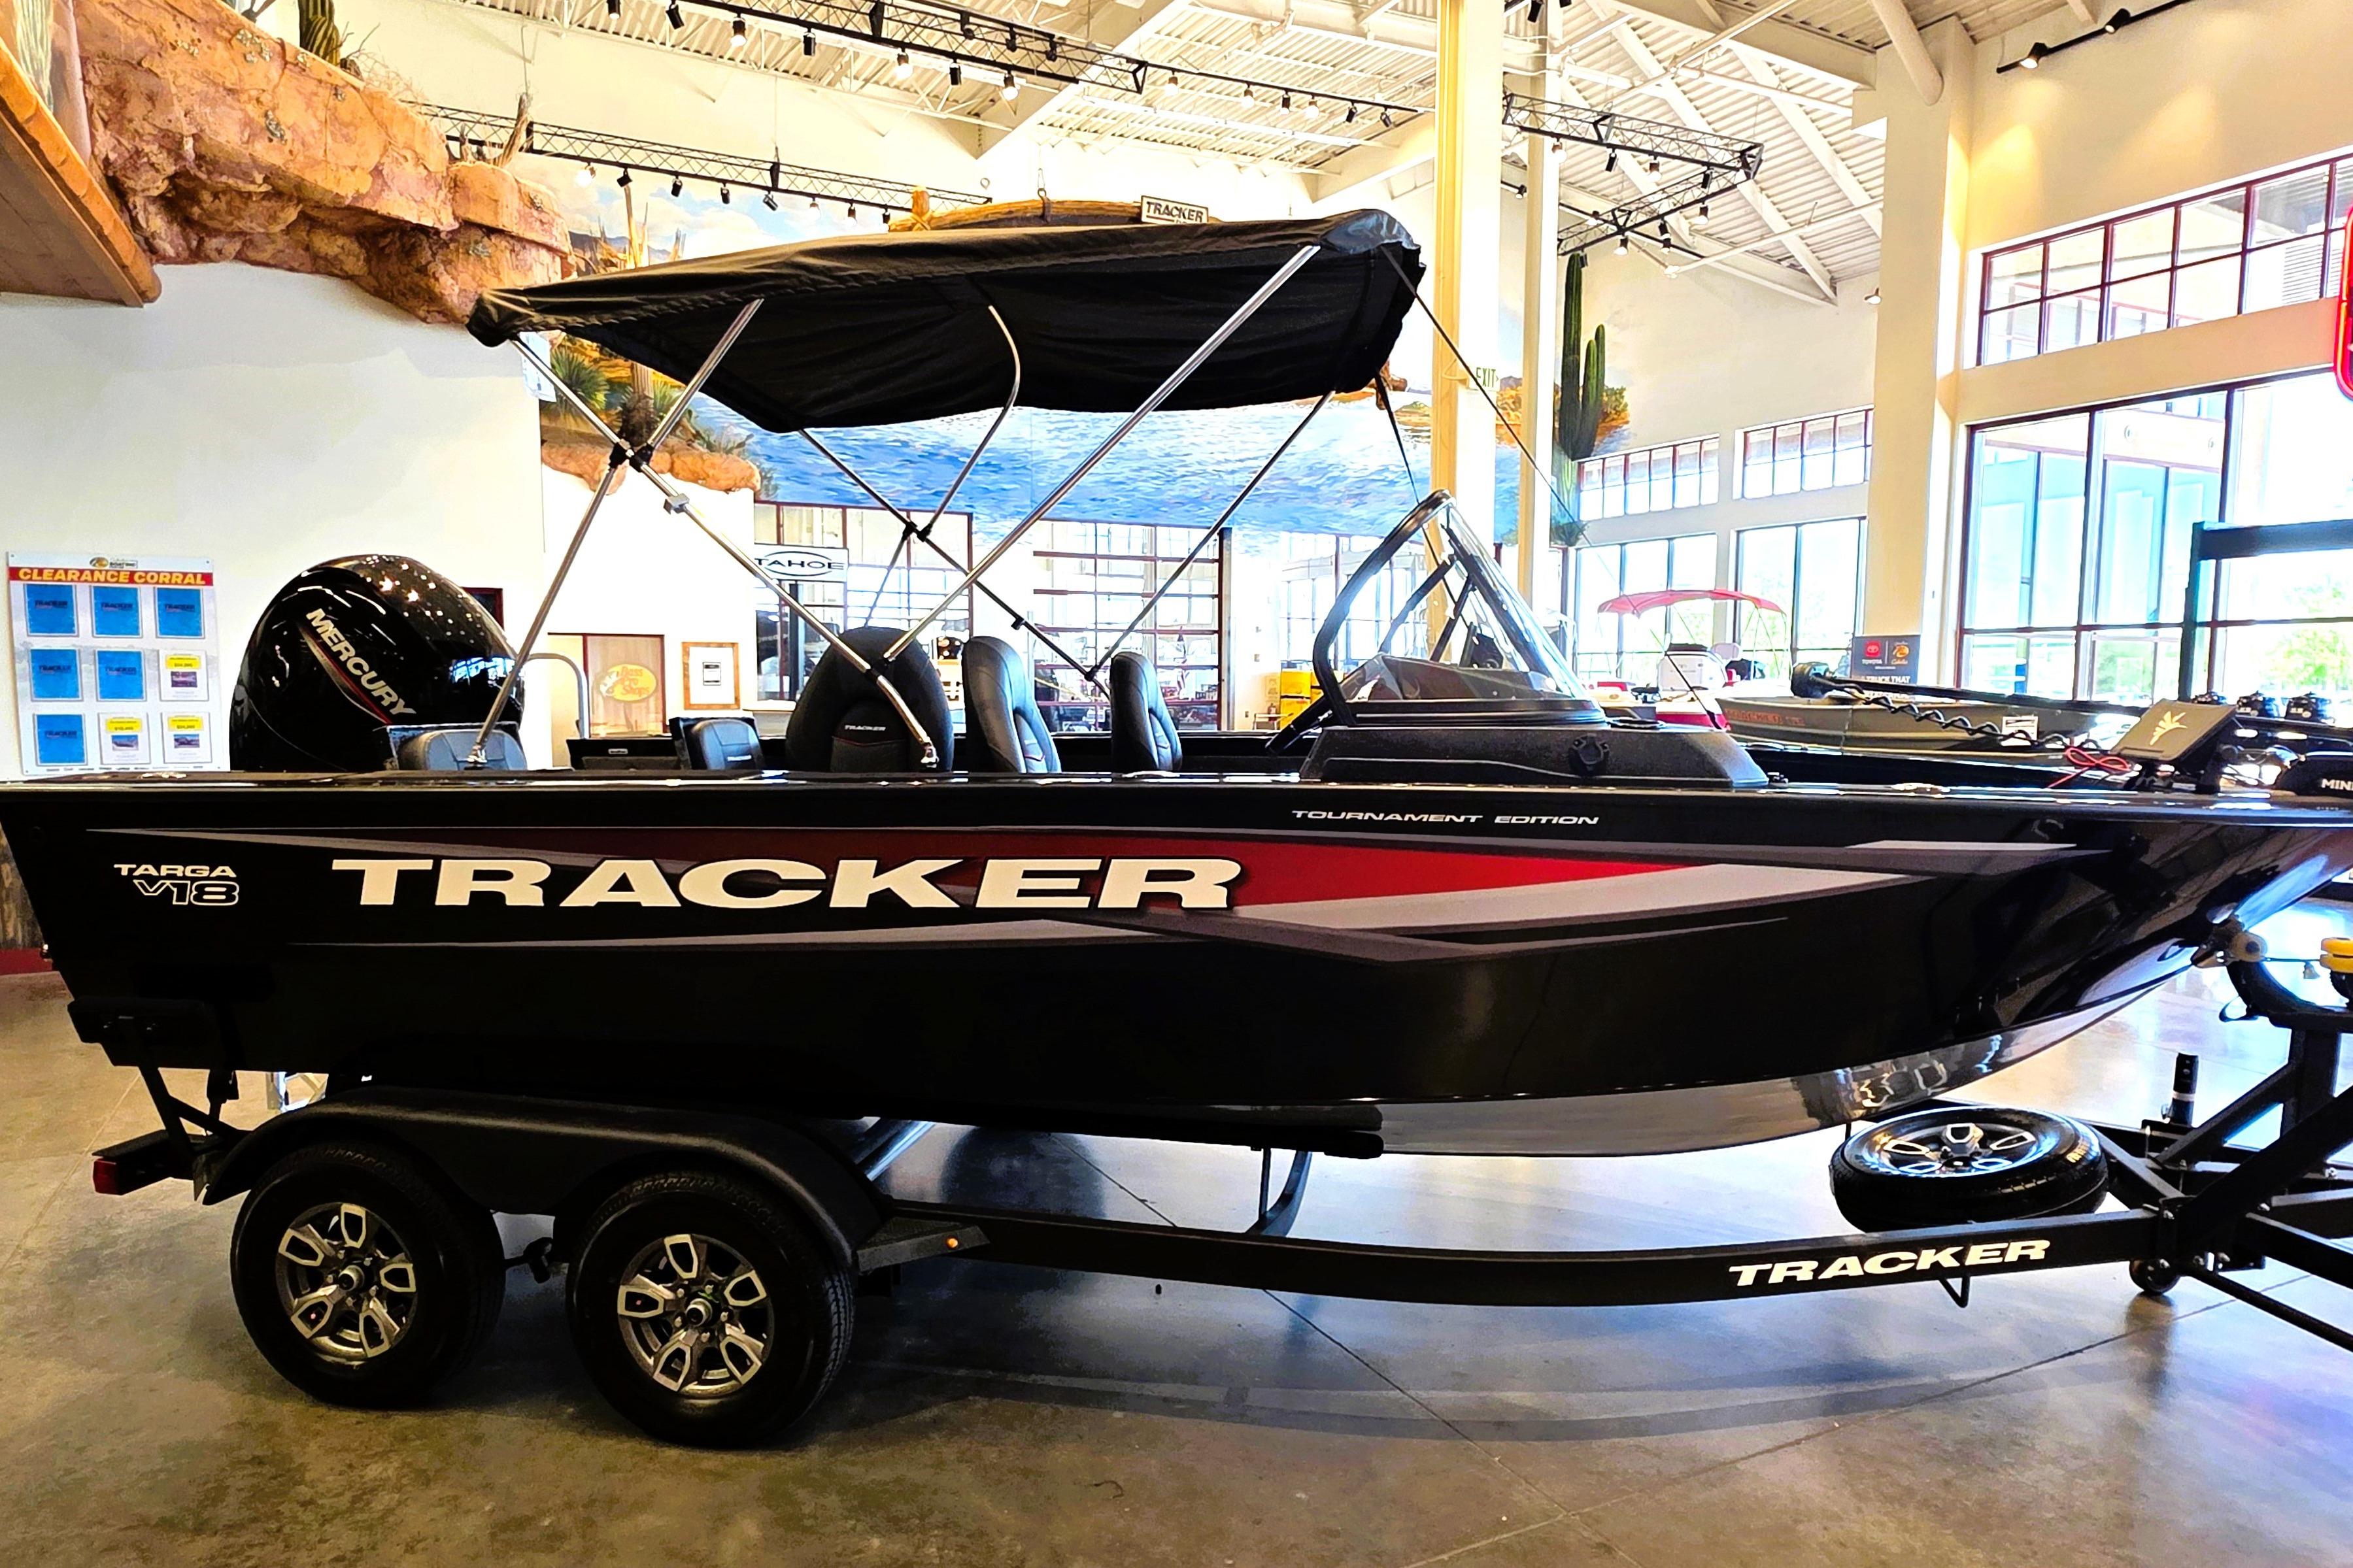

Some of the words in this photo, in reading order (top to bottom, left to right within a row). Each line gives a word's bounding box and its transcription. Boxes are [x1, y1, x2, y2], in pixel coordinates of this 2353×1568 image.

[1146, 201, 1204, 224] TRACKER
[1476, 367, 1497, 388] EXIT
[754, 558, 845, 571] TAHOE
[18, 568, 130, 583] CLEARANCE
[133, 571, 206, 585] CORRAL
[306, 608, 417, 714] MERCURY
[620, 666, 643, 677] Bass
[1890, 676, 1910, 684] THAT
[622, 685, 651, 697] Shops
[1292, 810, 1483, 823] TOURNAMENT
[1494, 816, 1599, 824] EDITION
[113, 863, 237, 878] TARGA
[331, 858, 1242, 909] TRACKER
[132, 879, 240, 906] V18
[1729, 1239, 2051, 1287] TRACKER
